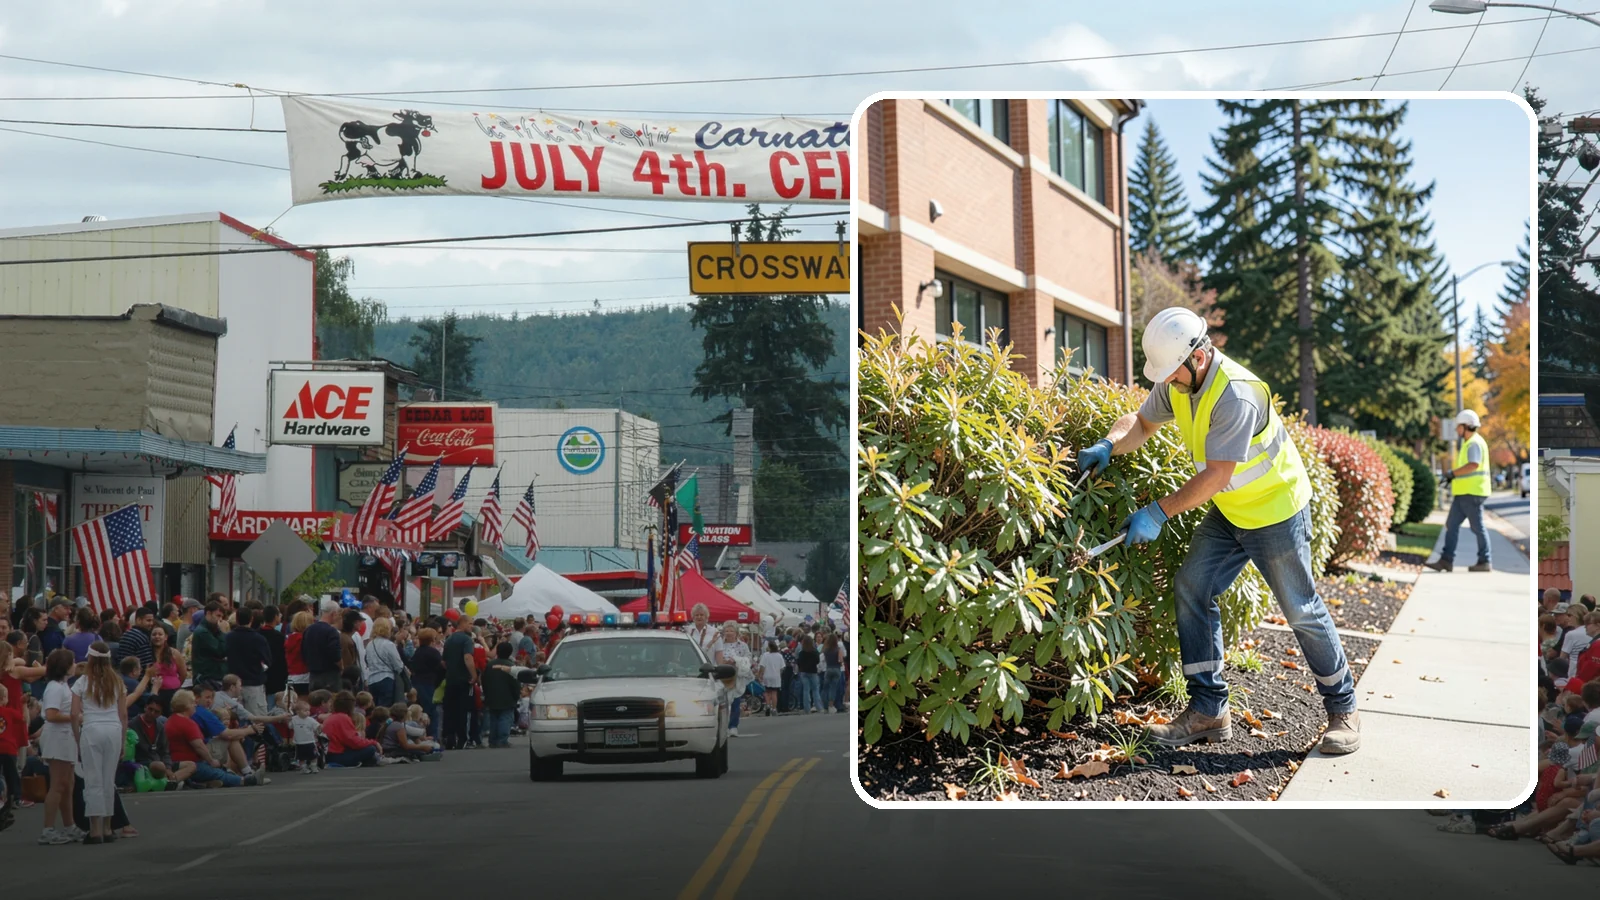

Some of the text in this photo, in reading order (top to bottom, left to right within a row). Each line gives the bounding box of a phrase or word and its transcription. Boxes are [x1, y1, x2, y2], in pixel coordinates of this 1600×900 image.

[481, 141, 605, 192] JULY
[632, 150, 746, 198] 4th.
[697, 254, 850, 279] CROSSWA
[283, 380, 373, 420] ACE
[405, 408, 486, 422] CEDAR LOG
[283, 421, 370, 436] Hardware
[95, 485, 124, 495] Vincent
[126, 486, 136, 494] de
[138, 486, 155, 495] Paul
[212, 516, 331, 535] HARDARE
[688, 526, 741, 535] CRNATION
[699, 535, 730, 543] GLASS
